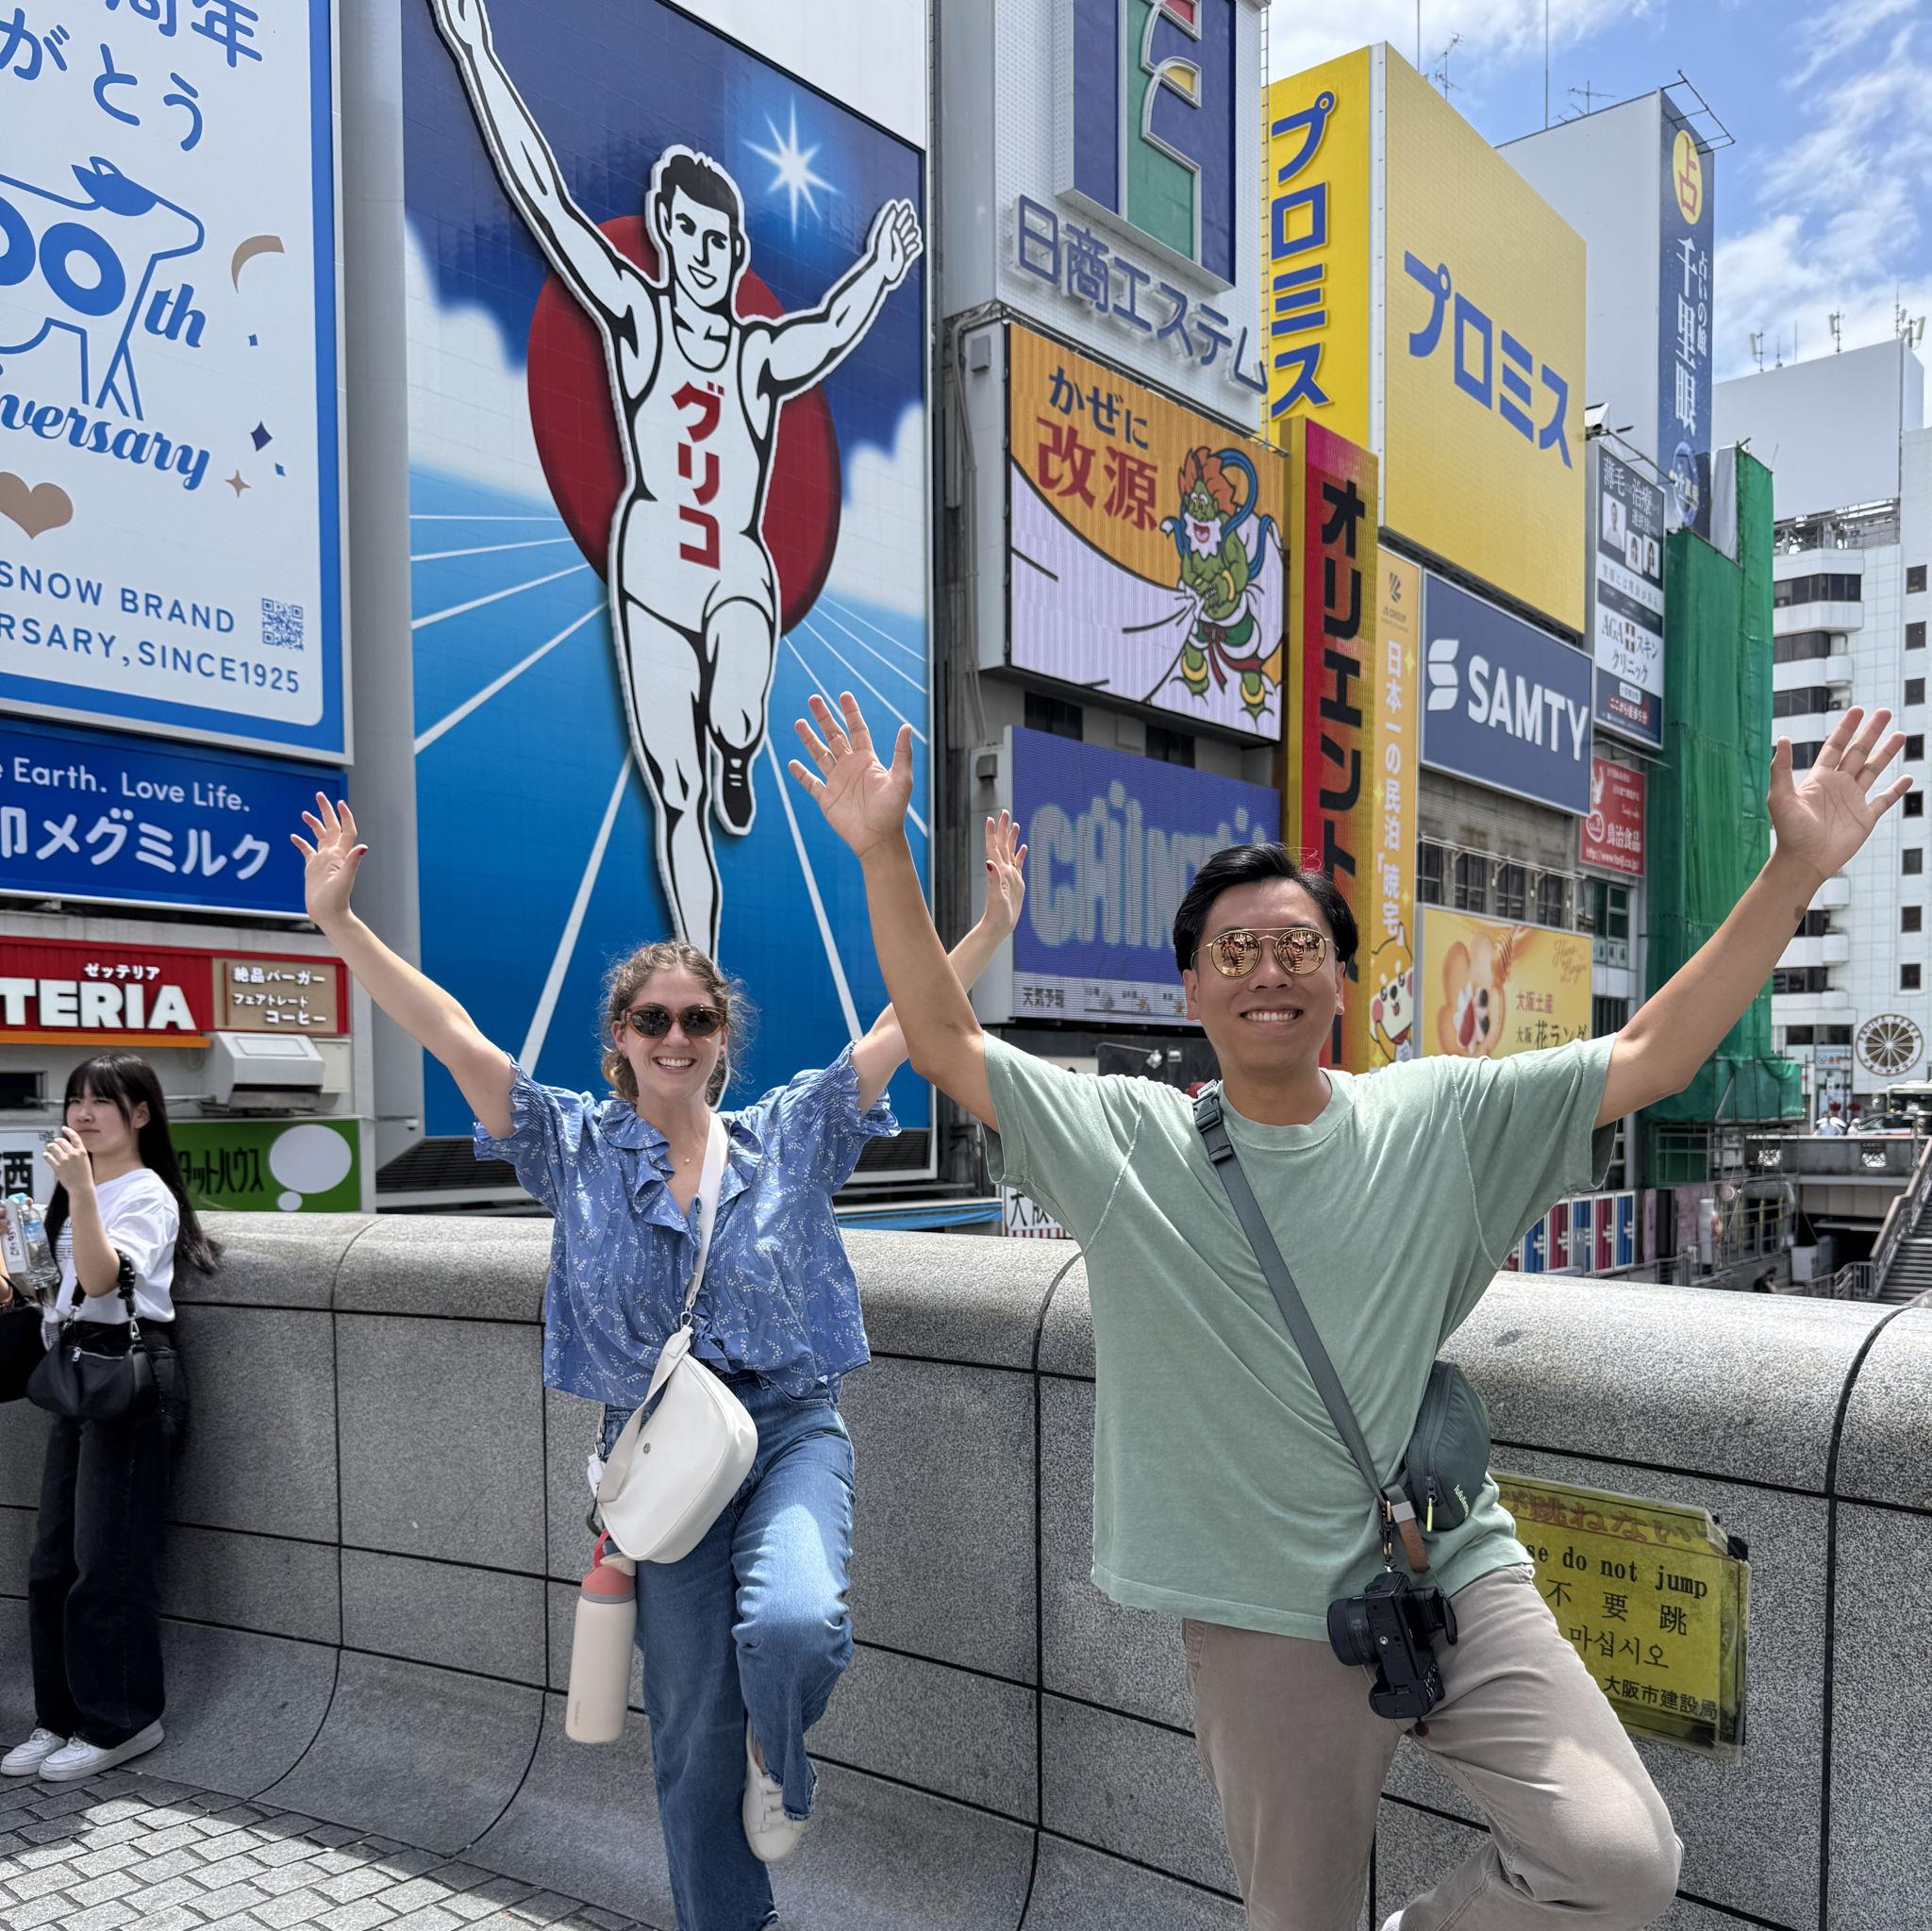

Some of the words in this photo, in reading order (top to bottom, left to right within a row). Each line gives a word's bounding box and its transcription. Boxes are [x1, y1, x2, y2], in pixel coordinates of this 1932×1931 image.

[106, 0, 263, 68] 年
[1272, 91, 1335, 420] プロミス
[1012, 193, 1268, 394] 日商エステム
[1404, 249, 1574, 471] プロミス
[1674, 237, 1697, 438] 千里眼
[0, 393, 210, 491] versary
[1049, 366, 1149, 450] かぜに
[671, 380, 725, 571] グリコ
[1036, 415, 1158, 532] 改源
[0, 559, 103, 606] SNOW
[121, 587, 235, 633] BRAND
[1468, 654, 1589, 762] SAMTY
[14, 757, 108, 793] Earth.
[121, 772, 185, 803] Love
[193, 782, 250, 812] Life.
[0, 977, 197, 1031] TERIA
[84, 962, 160, 980] ゼッテリア
[232, 992, 309, 1008] フェアトレード
[233, 966, 326, 986] 絶品バーガー
[265, 1009, 327, 1025] コーヒー
[1562, 1546, 1588, 1571] do
[1600, 1559, 1638, 1582] not
[1656, 1565, 1707, 1599] jump
[1605, 1674, 1718, 1721] 大阪市建設局
